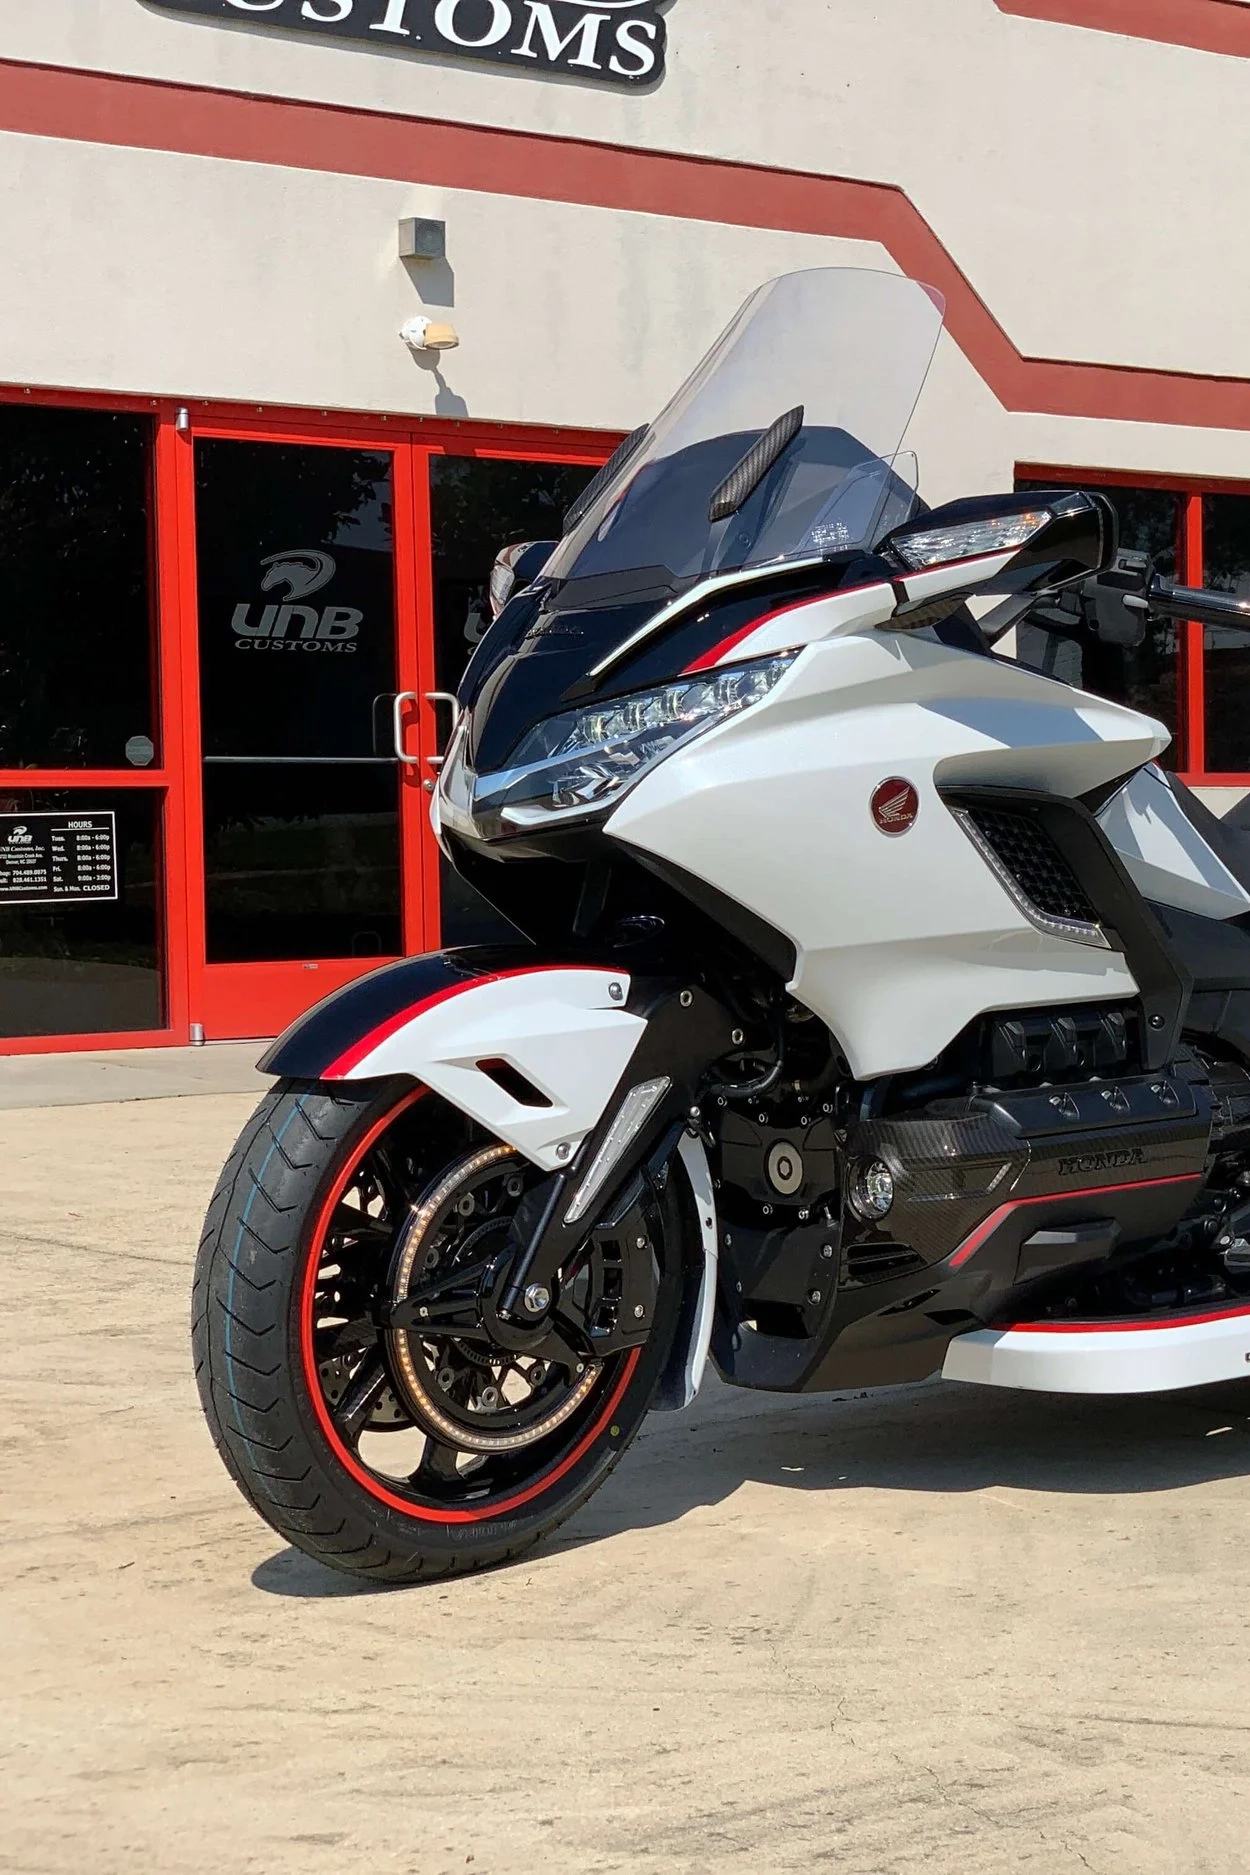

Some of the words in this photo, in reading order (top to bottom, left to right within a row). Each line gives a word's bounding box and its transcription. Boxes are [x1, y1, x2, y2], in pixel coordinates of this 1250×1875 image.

[222, 0, 656, 77] TOMS
[234, 638, 358, 653] CUSTOMS
[68, 821, 93, 829] HOURS
[1058, 1147, 1148, 1176] HONDA
